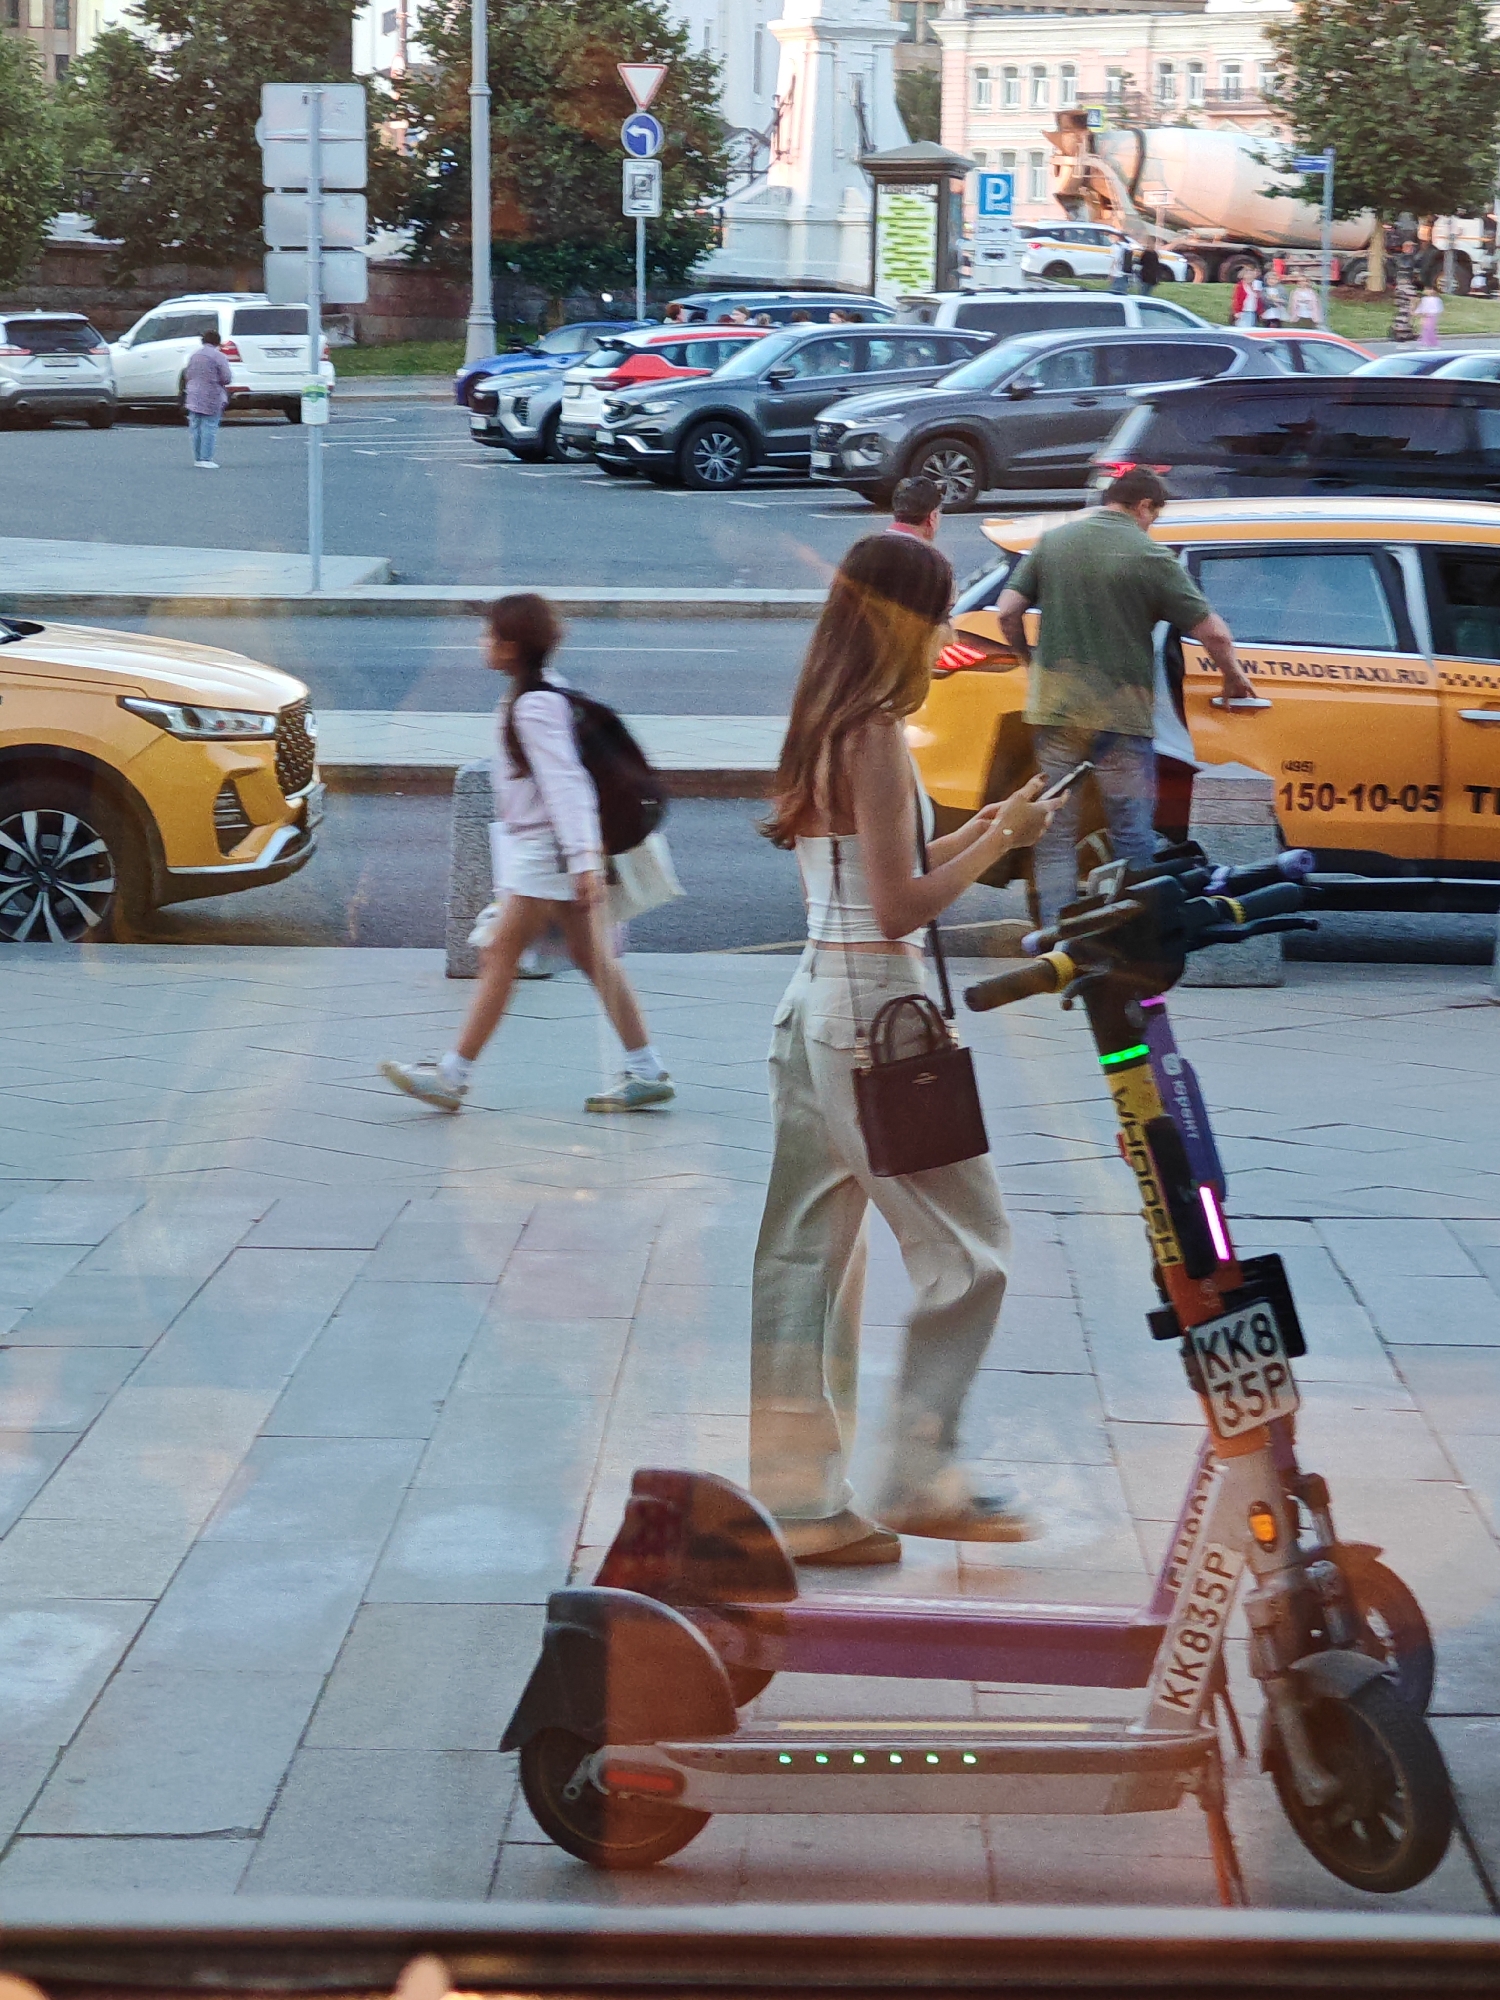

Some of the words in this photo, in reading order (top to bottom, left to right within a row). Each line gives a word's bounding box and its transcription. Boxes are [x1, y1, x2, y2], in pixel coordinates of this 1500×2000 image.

[1196, 656, 1429, 687] WW.TRADETAXI.RU
[1279, 781, 1443, 813] 150-10-05
[1463, 784, 1500, 816] T
